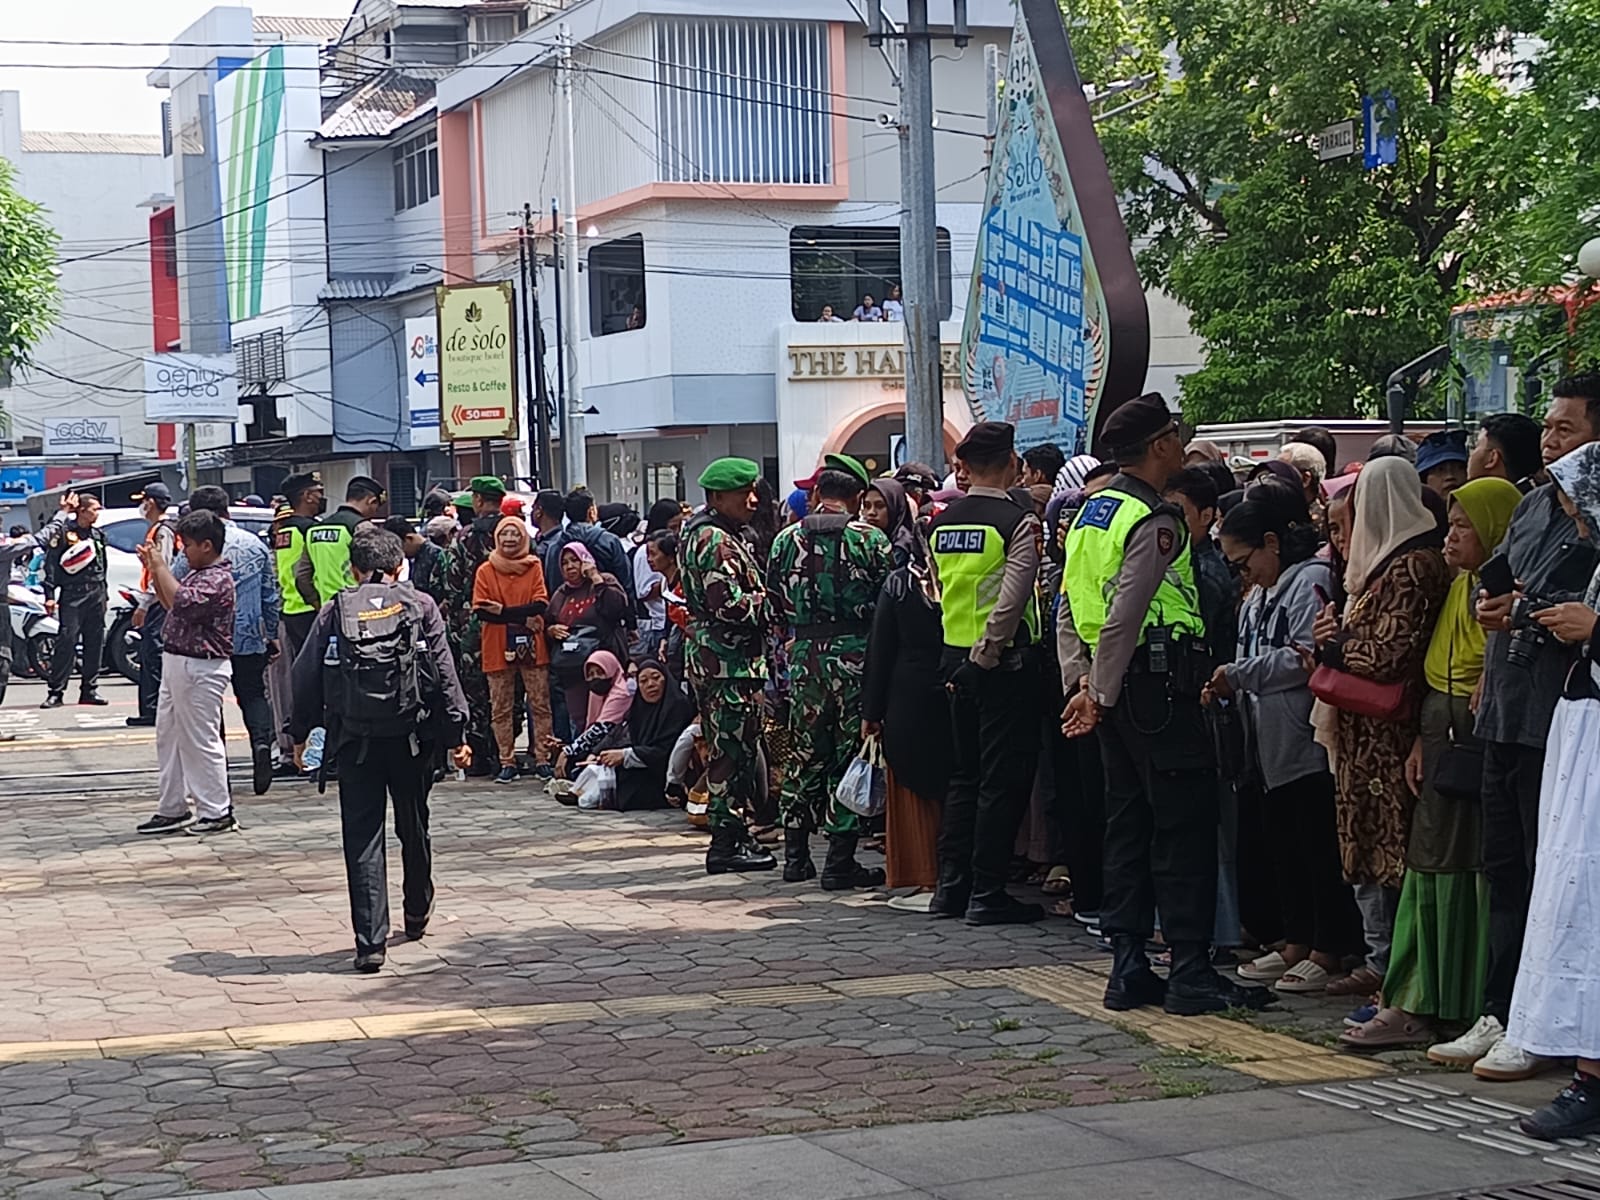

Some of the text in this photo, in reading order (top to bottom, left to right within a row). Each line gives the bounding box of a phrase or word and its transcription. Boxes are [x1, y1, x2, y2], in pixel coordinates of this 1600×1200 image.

[446, 325, 506, 351] de solo
[788, 351, 847, 375] THE
[447, 380, 507, 392] Resto & Coffee
[466, 409, 480, 419] 50
[938, 532, 982, 549] POLISI
